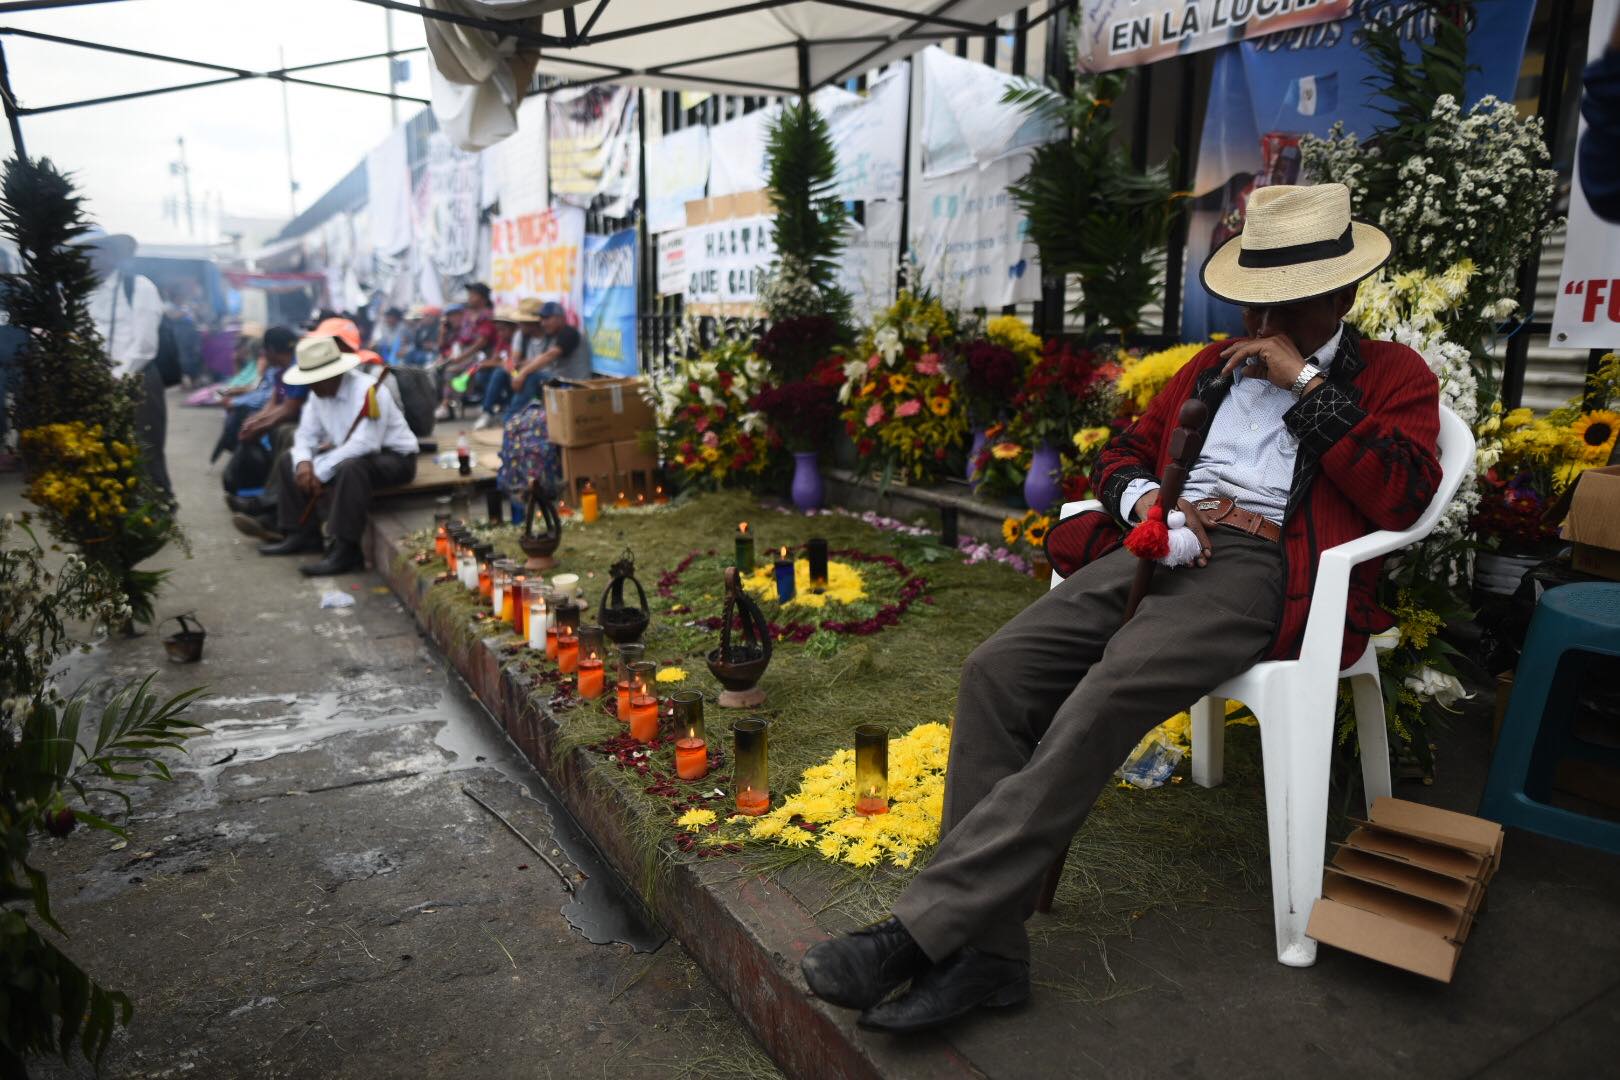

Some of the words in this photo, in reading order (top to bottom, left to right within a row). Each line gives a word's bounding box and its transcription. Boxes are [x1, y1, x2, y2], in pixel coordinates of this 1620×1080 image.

[1111, 16, 1150, 51] EN
[1162, 12, 1199, 41] LA
[1210, 0, 1336, 29] LUC
[705, 225, 767, 257] HASTA
[689, 269, 719, 296] QUE
